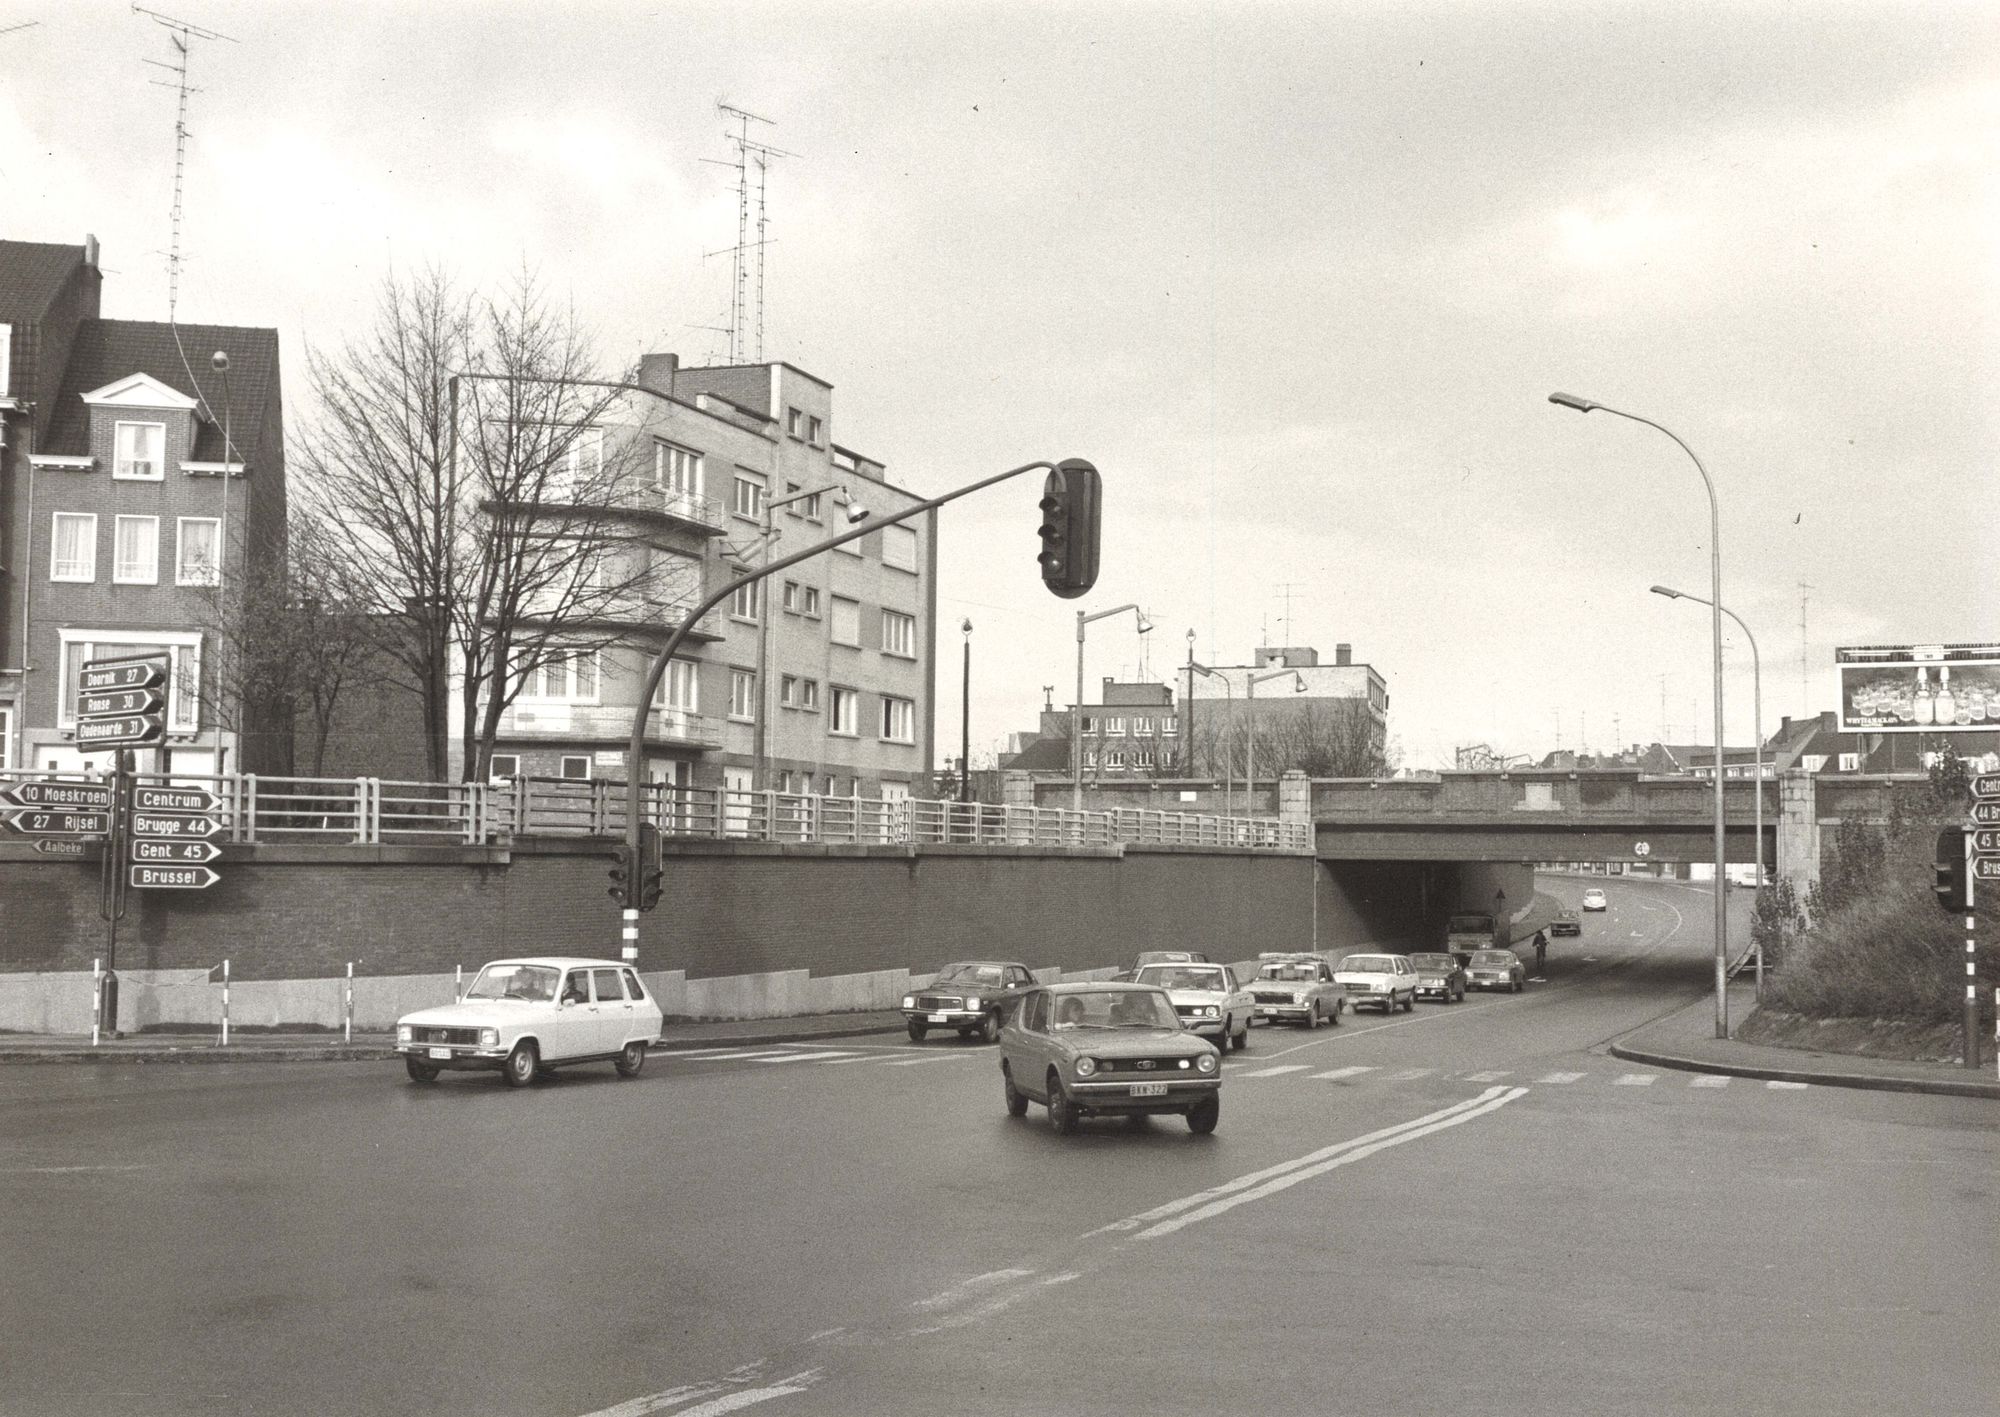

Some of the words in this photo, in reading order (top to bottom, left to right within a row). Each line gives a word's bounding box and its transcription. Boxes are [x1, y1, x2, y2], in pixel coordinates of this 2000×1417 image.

[88, 671, 115, 686] Doornik
[126, 669, 138, 682] 27
[88, 698, 110, 711] Ronse
[123, 695, 134, 708] 30
[80, 722, 122, 738] Oudenaarde
[129, 720, 138, 733] 31
[26, 787, 38, 800] 10
[45, 787, 107, 803] Moeskroen
[143, 792, 201, 807] Centrum
[1978, 806, 1988, 820] 44
[33, 815, 50, 828] 27
[65, 816, 98, 832] Rijsel
[137, 818, 180, 834] Brugge
[187, 820, 205, 832] 44
[45, 841, 82, 853] Aalbeke
[1981, 833, 1991, 847] 45
[140, 843, 171, 857] Gent
[183, 845, 201, 858] 45
[143, 870, 196, 884] Brussel
